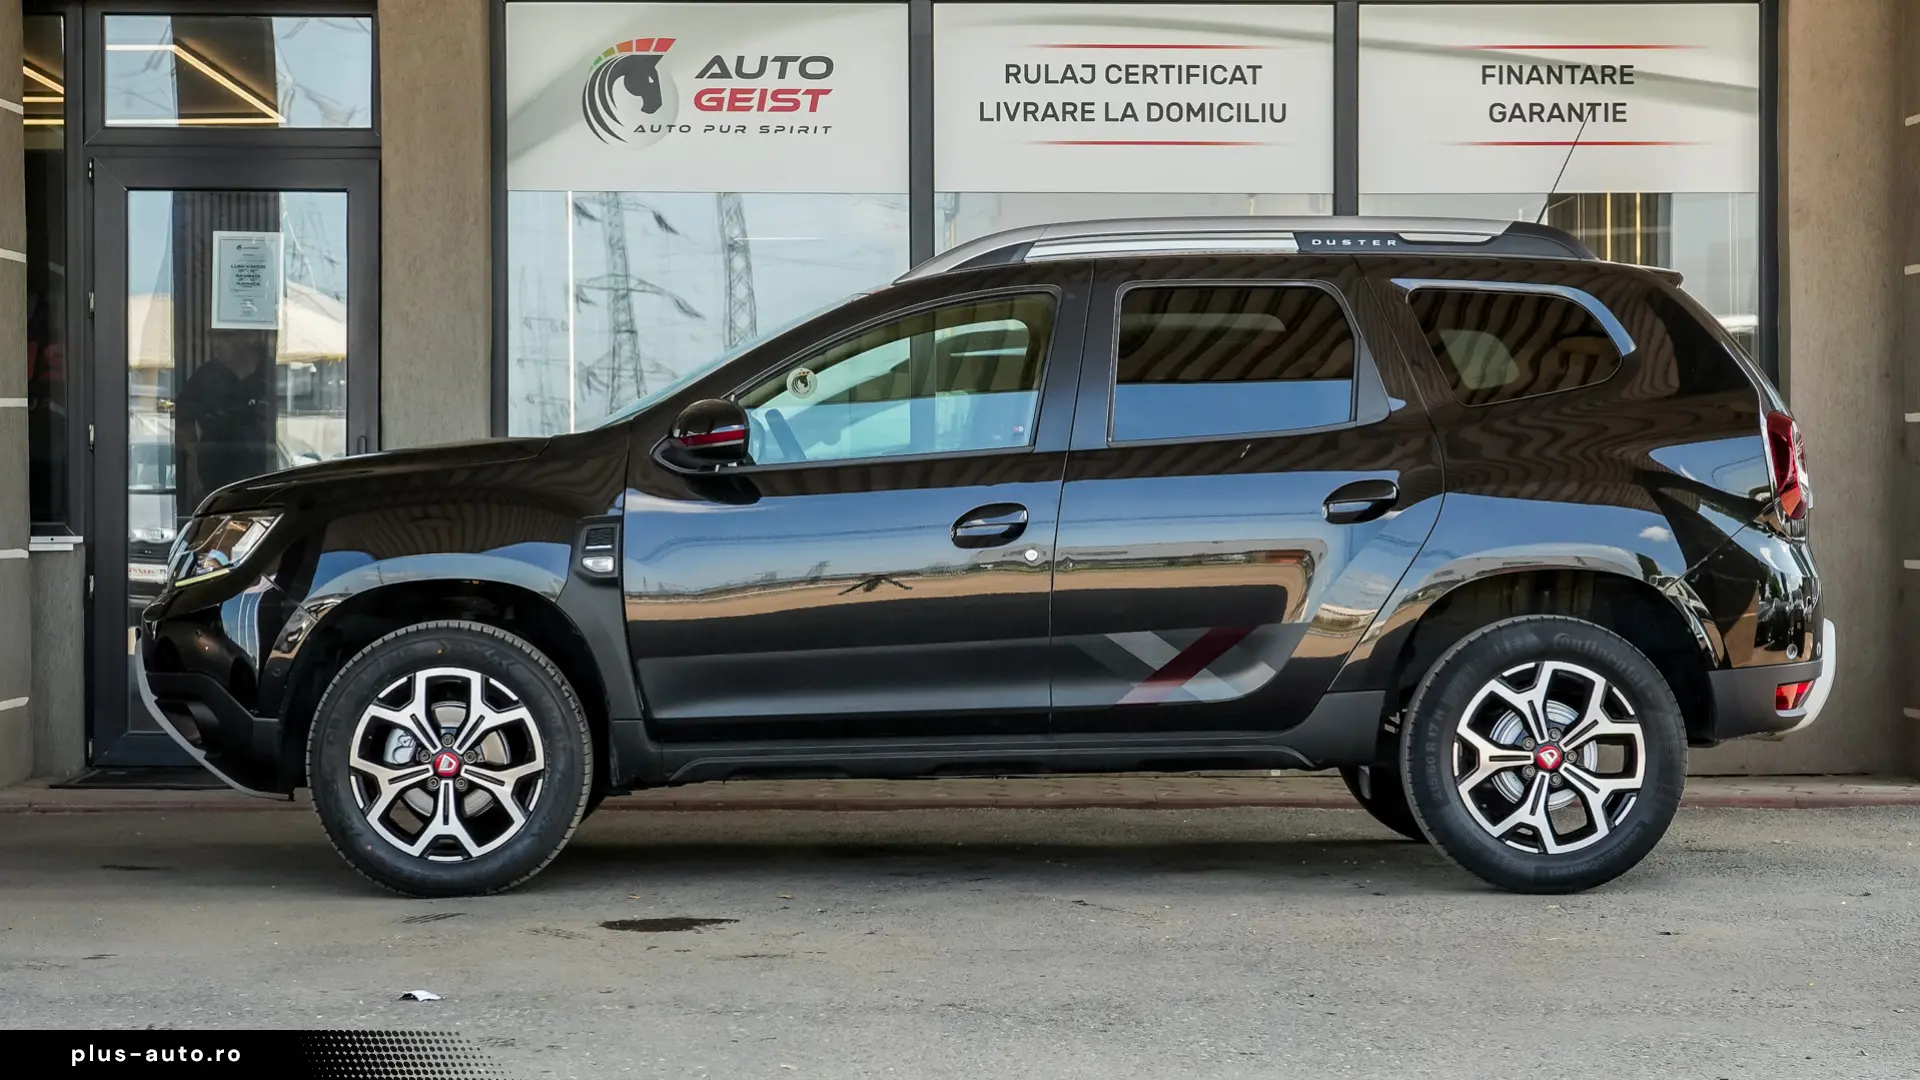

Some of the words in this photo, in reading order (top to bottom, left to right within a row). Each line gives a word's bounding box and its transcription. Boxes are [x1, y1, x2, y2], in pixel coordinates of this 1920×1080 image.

[694, 54, 835, 80] AUTO
[1004, 63, 1097, 84] RULAJ
[1104, 63, 1263, 85] CERTIFICAT
[1481, 64, 1635, 85] FINANTARE
[693, 87, 834, 113] GEIST
[979, 101, 1096, 122] LIVRARE
[1103, 101, 1139, 122] LA
[1146, 102, 1288, 124] DOMICILIU
[1488, 102, 1628, 123] GARANTIE
[633, 124, 692, 134] AUTO
[703, 125, 748, 135] PUR
[758, 124, 833, 135] SPIRIT
[1311, 238, 1397, 246] DUSTER
